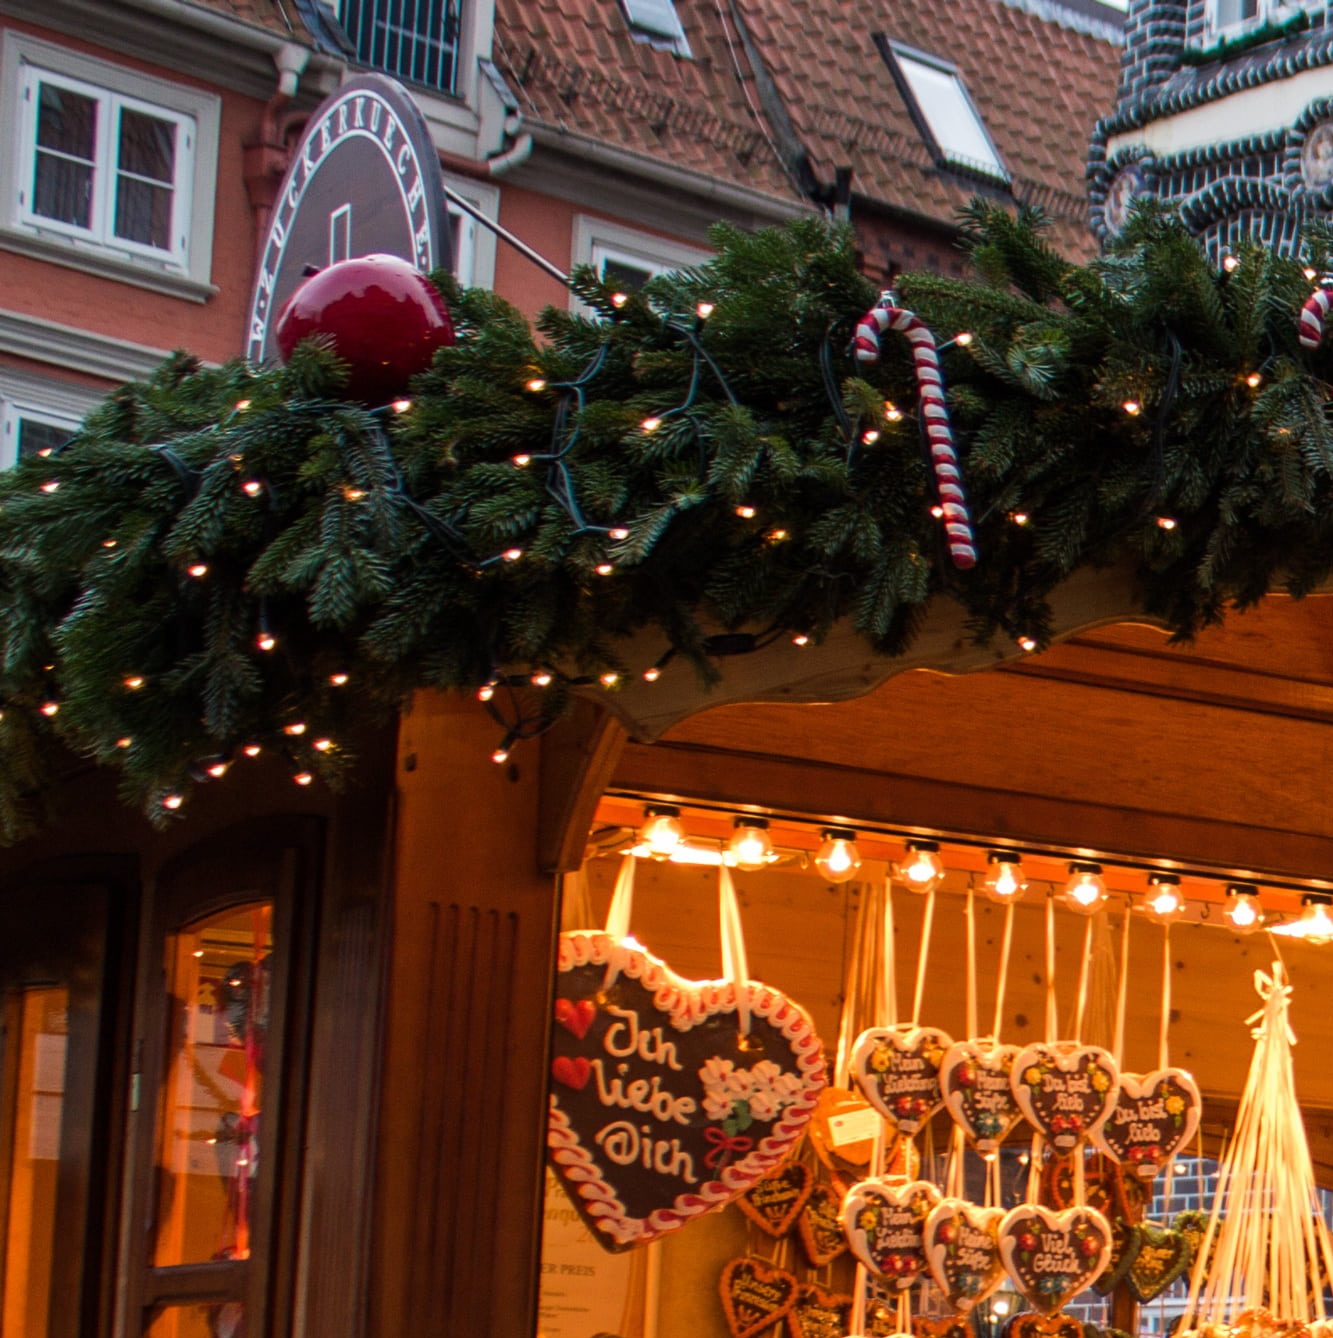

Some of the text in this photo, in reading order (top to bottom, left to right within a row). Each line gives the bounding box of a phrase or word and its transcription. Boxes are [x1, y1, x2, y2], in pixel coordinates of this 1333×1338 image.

[603, 1005, 683, 1071] Ich
[1042, 1072, 1092, 1094] Du bist
[1114, 1098, 1168, 1126] Du bist
[596, 1121, 696, 1184] Dich
[1033, 1252, 1082, 1274] Glück
